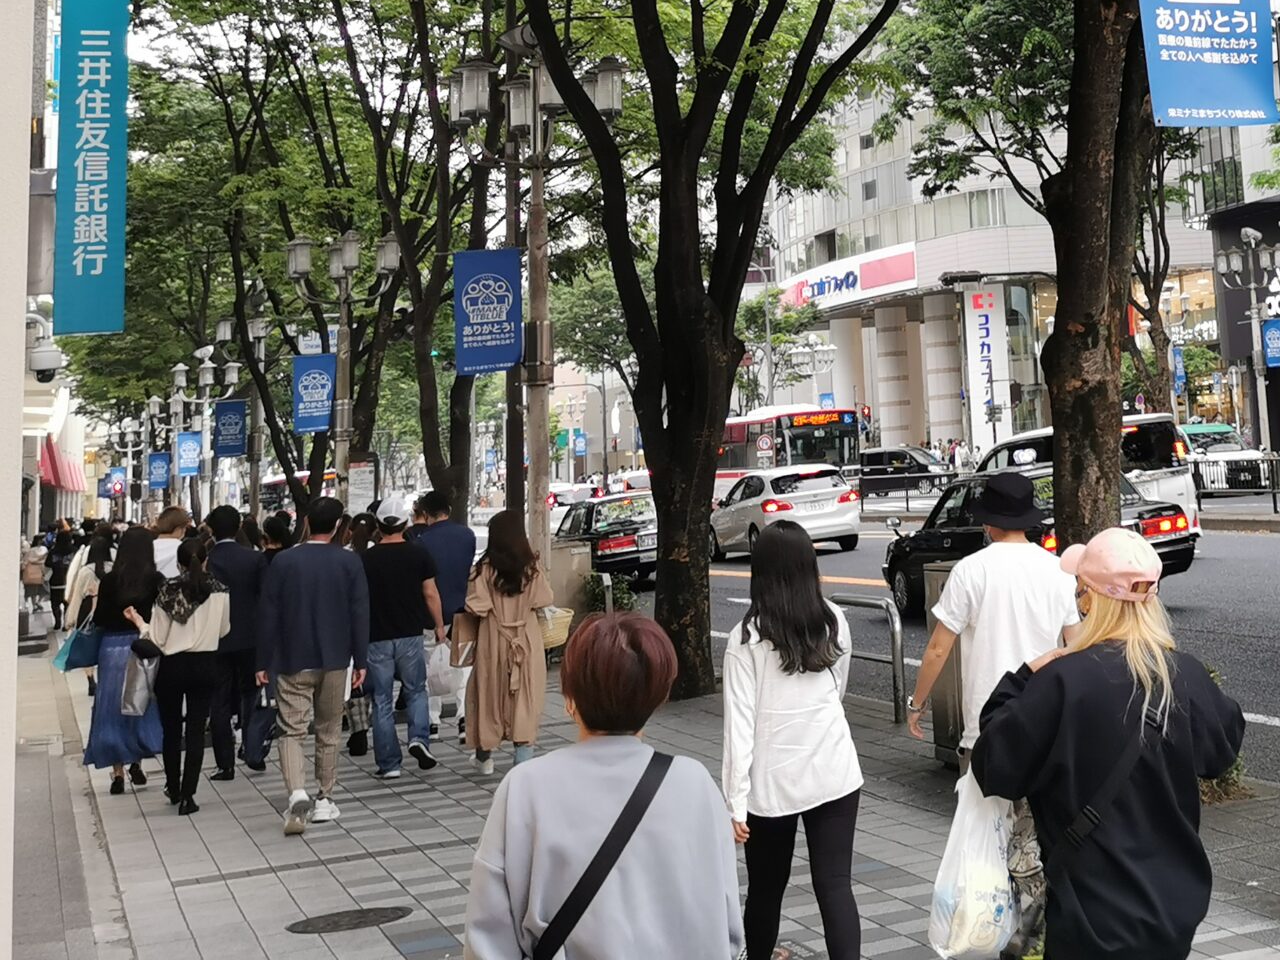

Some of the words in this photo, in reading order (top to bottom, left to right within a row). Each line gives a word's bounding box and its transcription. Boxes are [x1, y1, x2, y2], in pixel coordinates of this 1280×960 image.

[1158, 34, 1257, 50] 医療の最前線でたたかう
[1160, 49, 1258, 64] 全ての人へ感謝を込めて
[72, 29, 112, 276] 三井住友信託銀行
